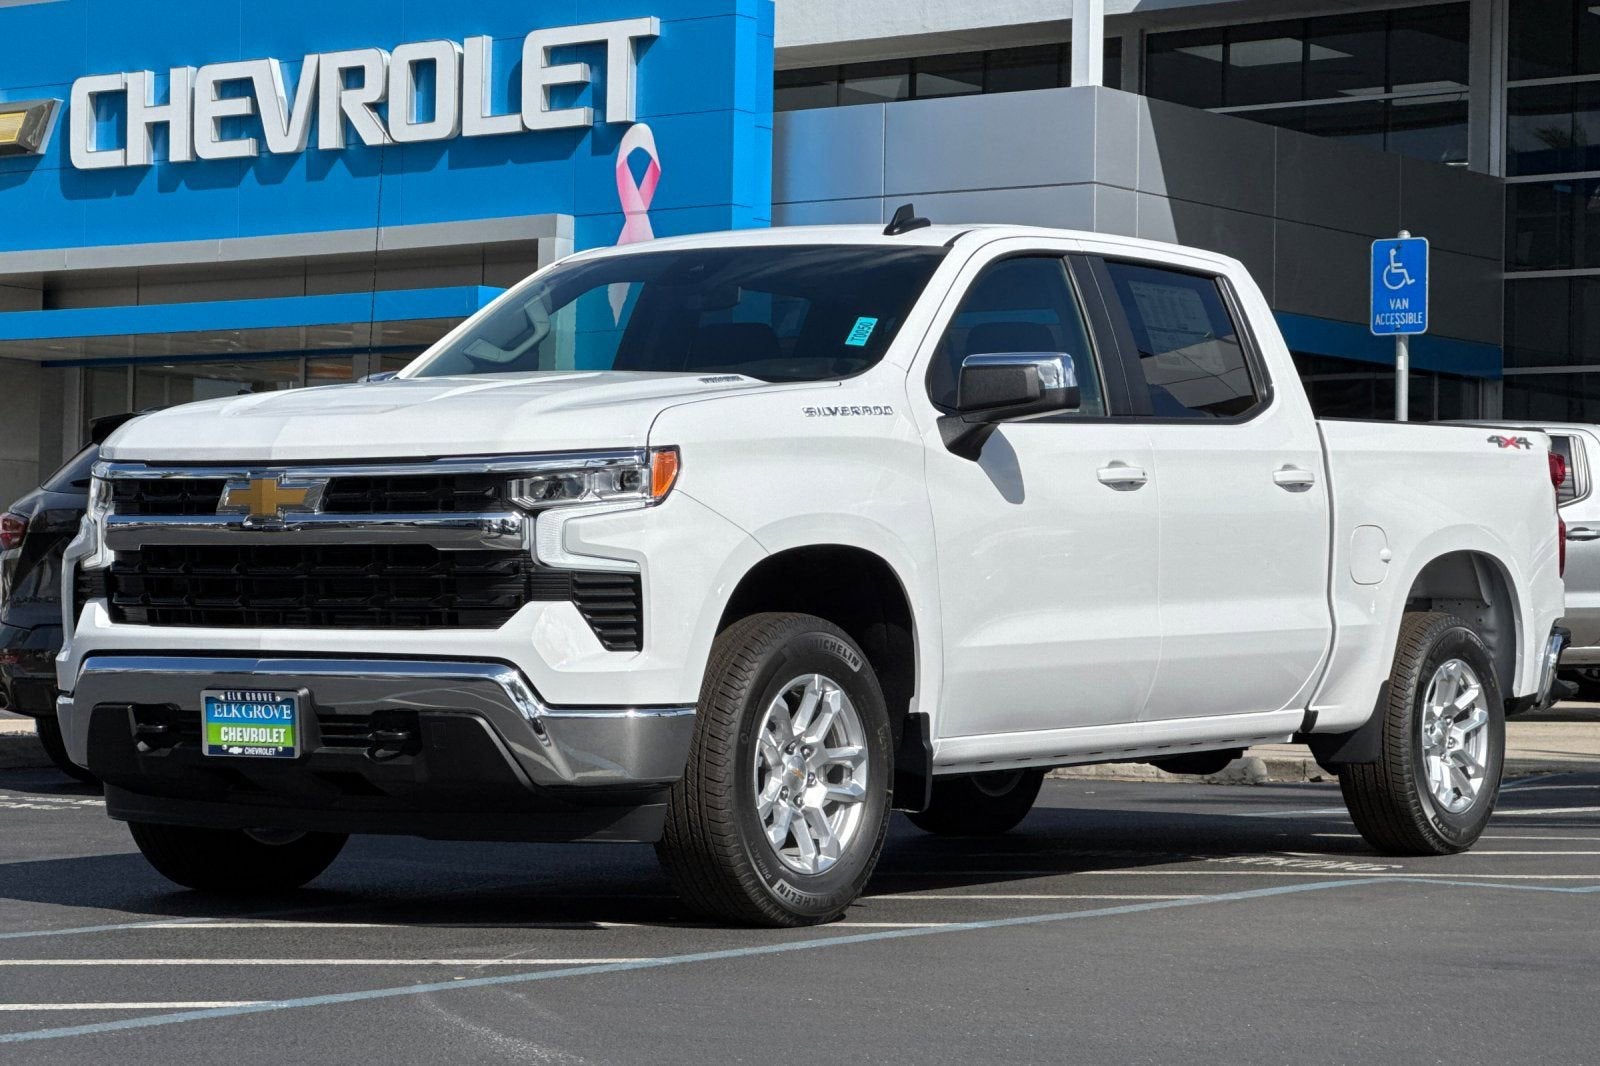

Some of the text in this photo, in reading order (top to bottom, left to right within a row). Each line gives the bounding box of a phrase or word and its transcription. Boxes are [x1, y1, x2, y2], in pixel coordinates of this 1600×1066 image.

[69, 15, 661, 171] CHEVROLET
[1389, 297, 1409, 310] VAN
[1375, 312, 1423, 326] ACCESSIBLE
[802, 405, 894, 417] SILVERADO
[809, 638, 860, 668] MICHELIN
[227, 691, 274, 702] ELK GROVE
[221, 726, 286, 743] CHEVROLET
[244, 746, 277, 756] CHEVROLET
